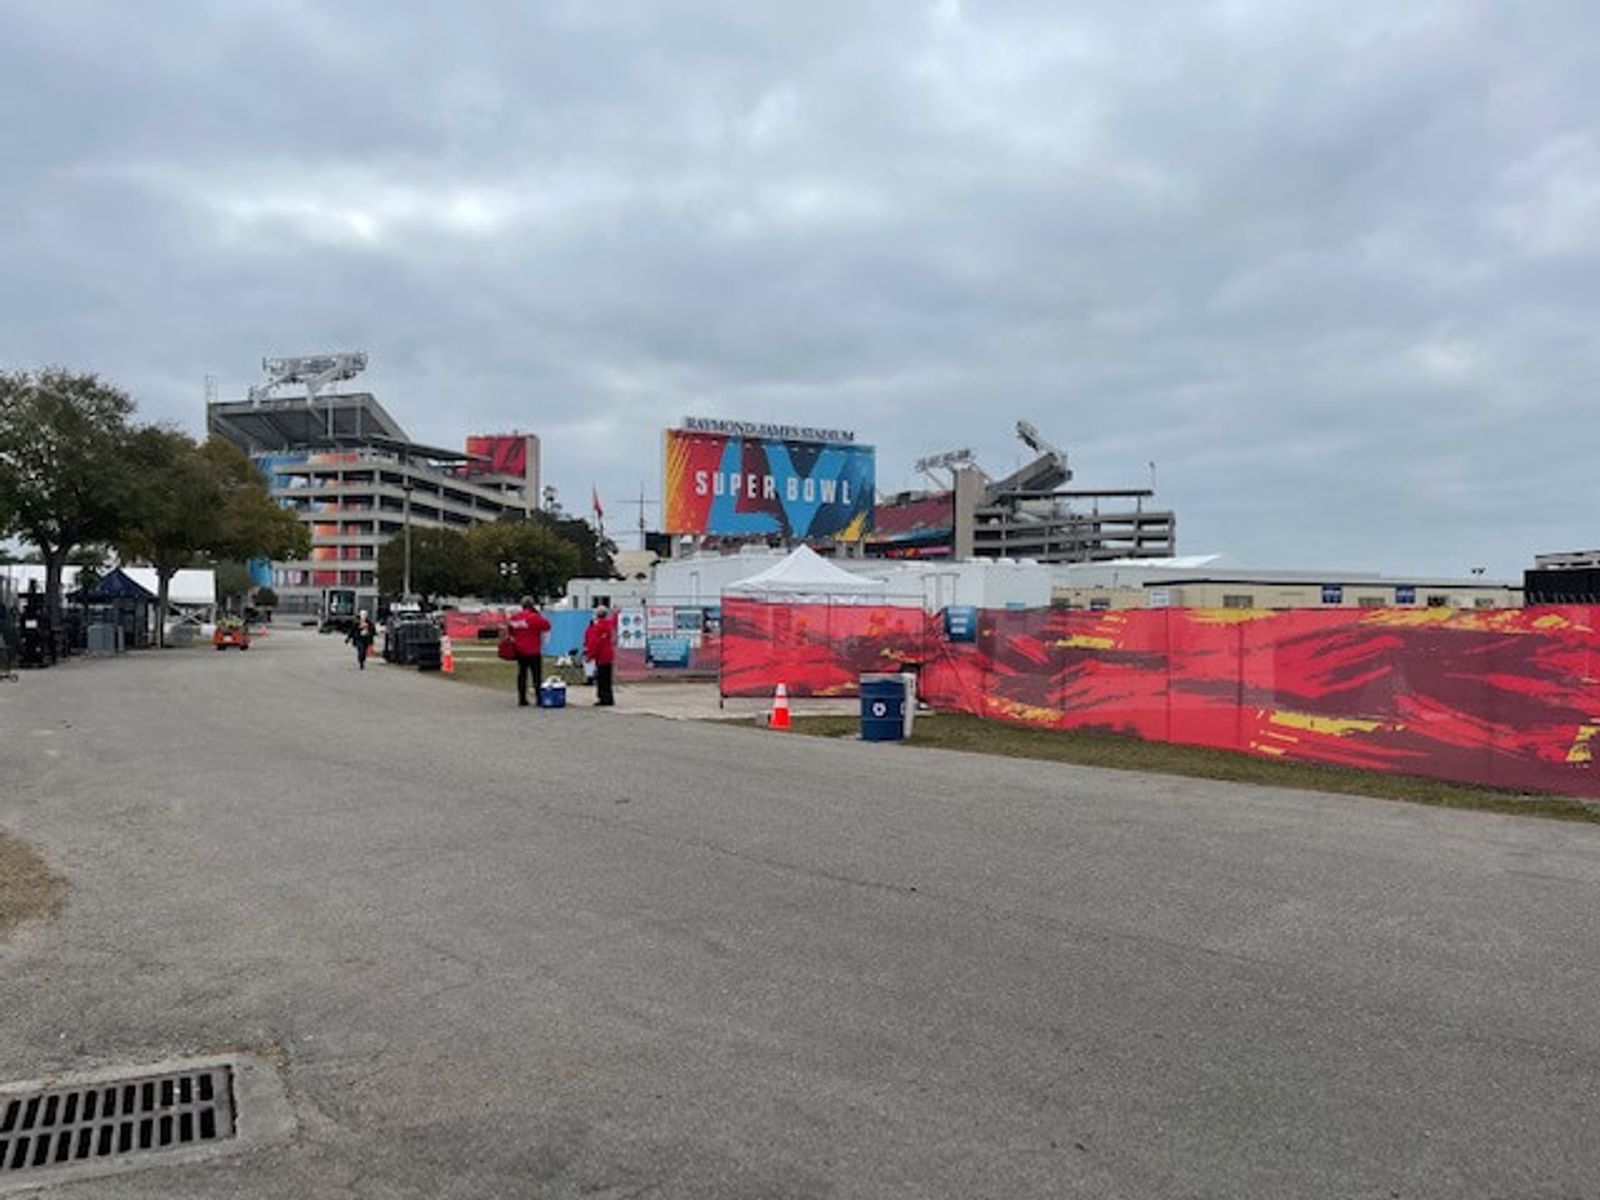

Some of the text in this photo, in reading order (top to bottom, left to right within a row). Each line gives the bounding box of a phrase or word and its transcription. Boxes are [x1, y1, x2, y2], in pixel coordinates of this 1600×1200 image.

[685, 416, 854, 441] RAYMOND JAMES STADIUM
[695, 470, 851, 504] SUPER BOWL
